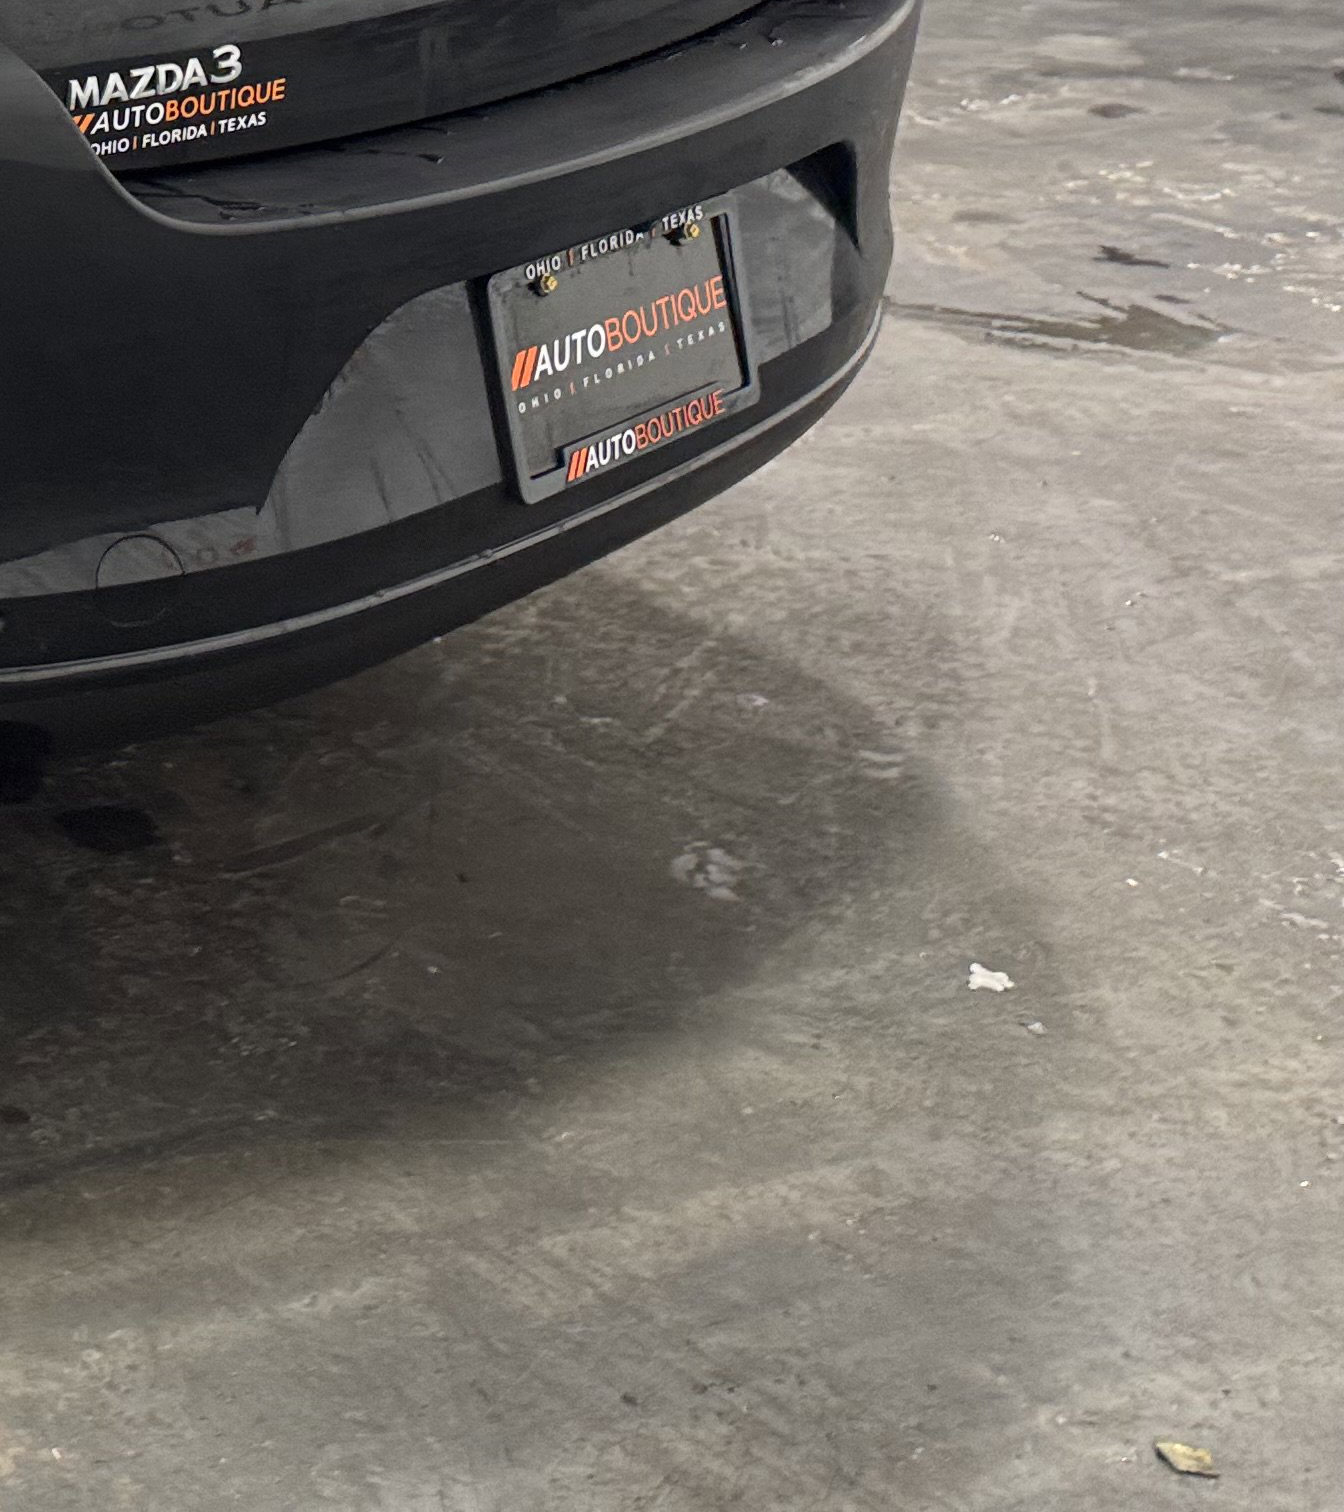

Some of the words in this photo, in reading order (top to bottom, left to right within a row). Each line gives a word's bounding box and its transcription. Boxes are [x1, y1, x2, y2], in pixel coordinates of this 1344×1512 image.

[90, 78, 287, 135] AUTOBOUTIQUE
[141, 124, 208, 149] FLORIDA
[217, 111, 268, 135] TEXAS
[525, 255, 561, 280] OHIO
[662, 205, 703, 231] TEXAS
[517, 388, 562, 414] OHIO
[583, 351, 656, 389] FLORIDA
[676, 321, 727, 350] TEXAS
[533, 275, 727, 382] AUTOBOUTIQUE
[585, 388, 727, 474] AUTOBOUTIQUE
